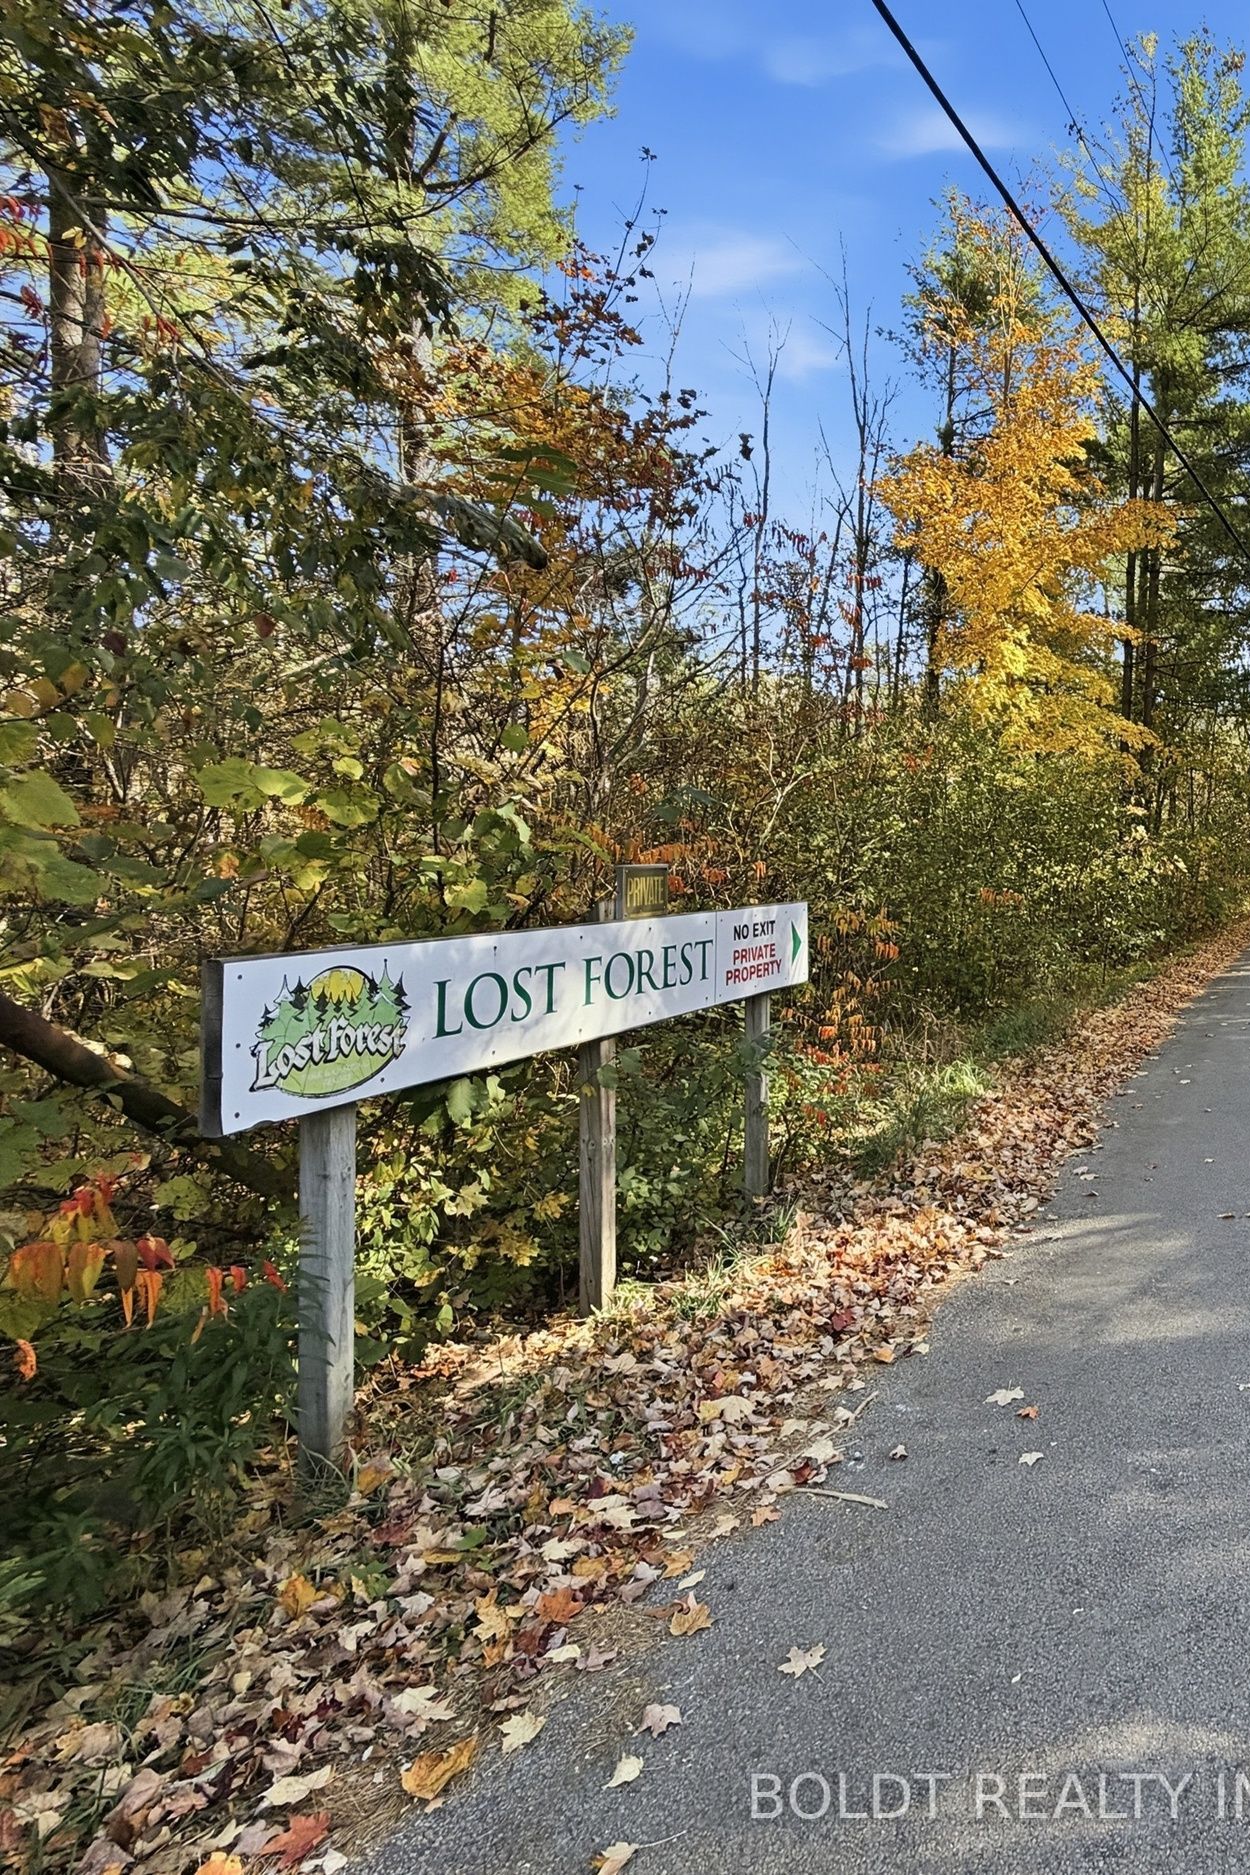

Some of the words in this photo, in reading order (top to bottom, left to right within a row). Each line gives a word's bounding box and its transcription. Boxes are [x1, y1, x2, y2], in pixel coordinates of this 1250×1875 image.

[627, 877, 664, 908] PRIVATE
[733, 925, 749, 941] NO
[753, 920, 776, 938] EXIT
[733, 943, 776, 965] PRIVATE
[725, 959, 782, 986] PROPERTY
[433, 961, 566, 1039] LOST
[583, 939, 714, 1006] FOREST
[250, 1023, 327, 1092] Lost
